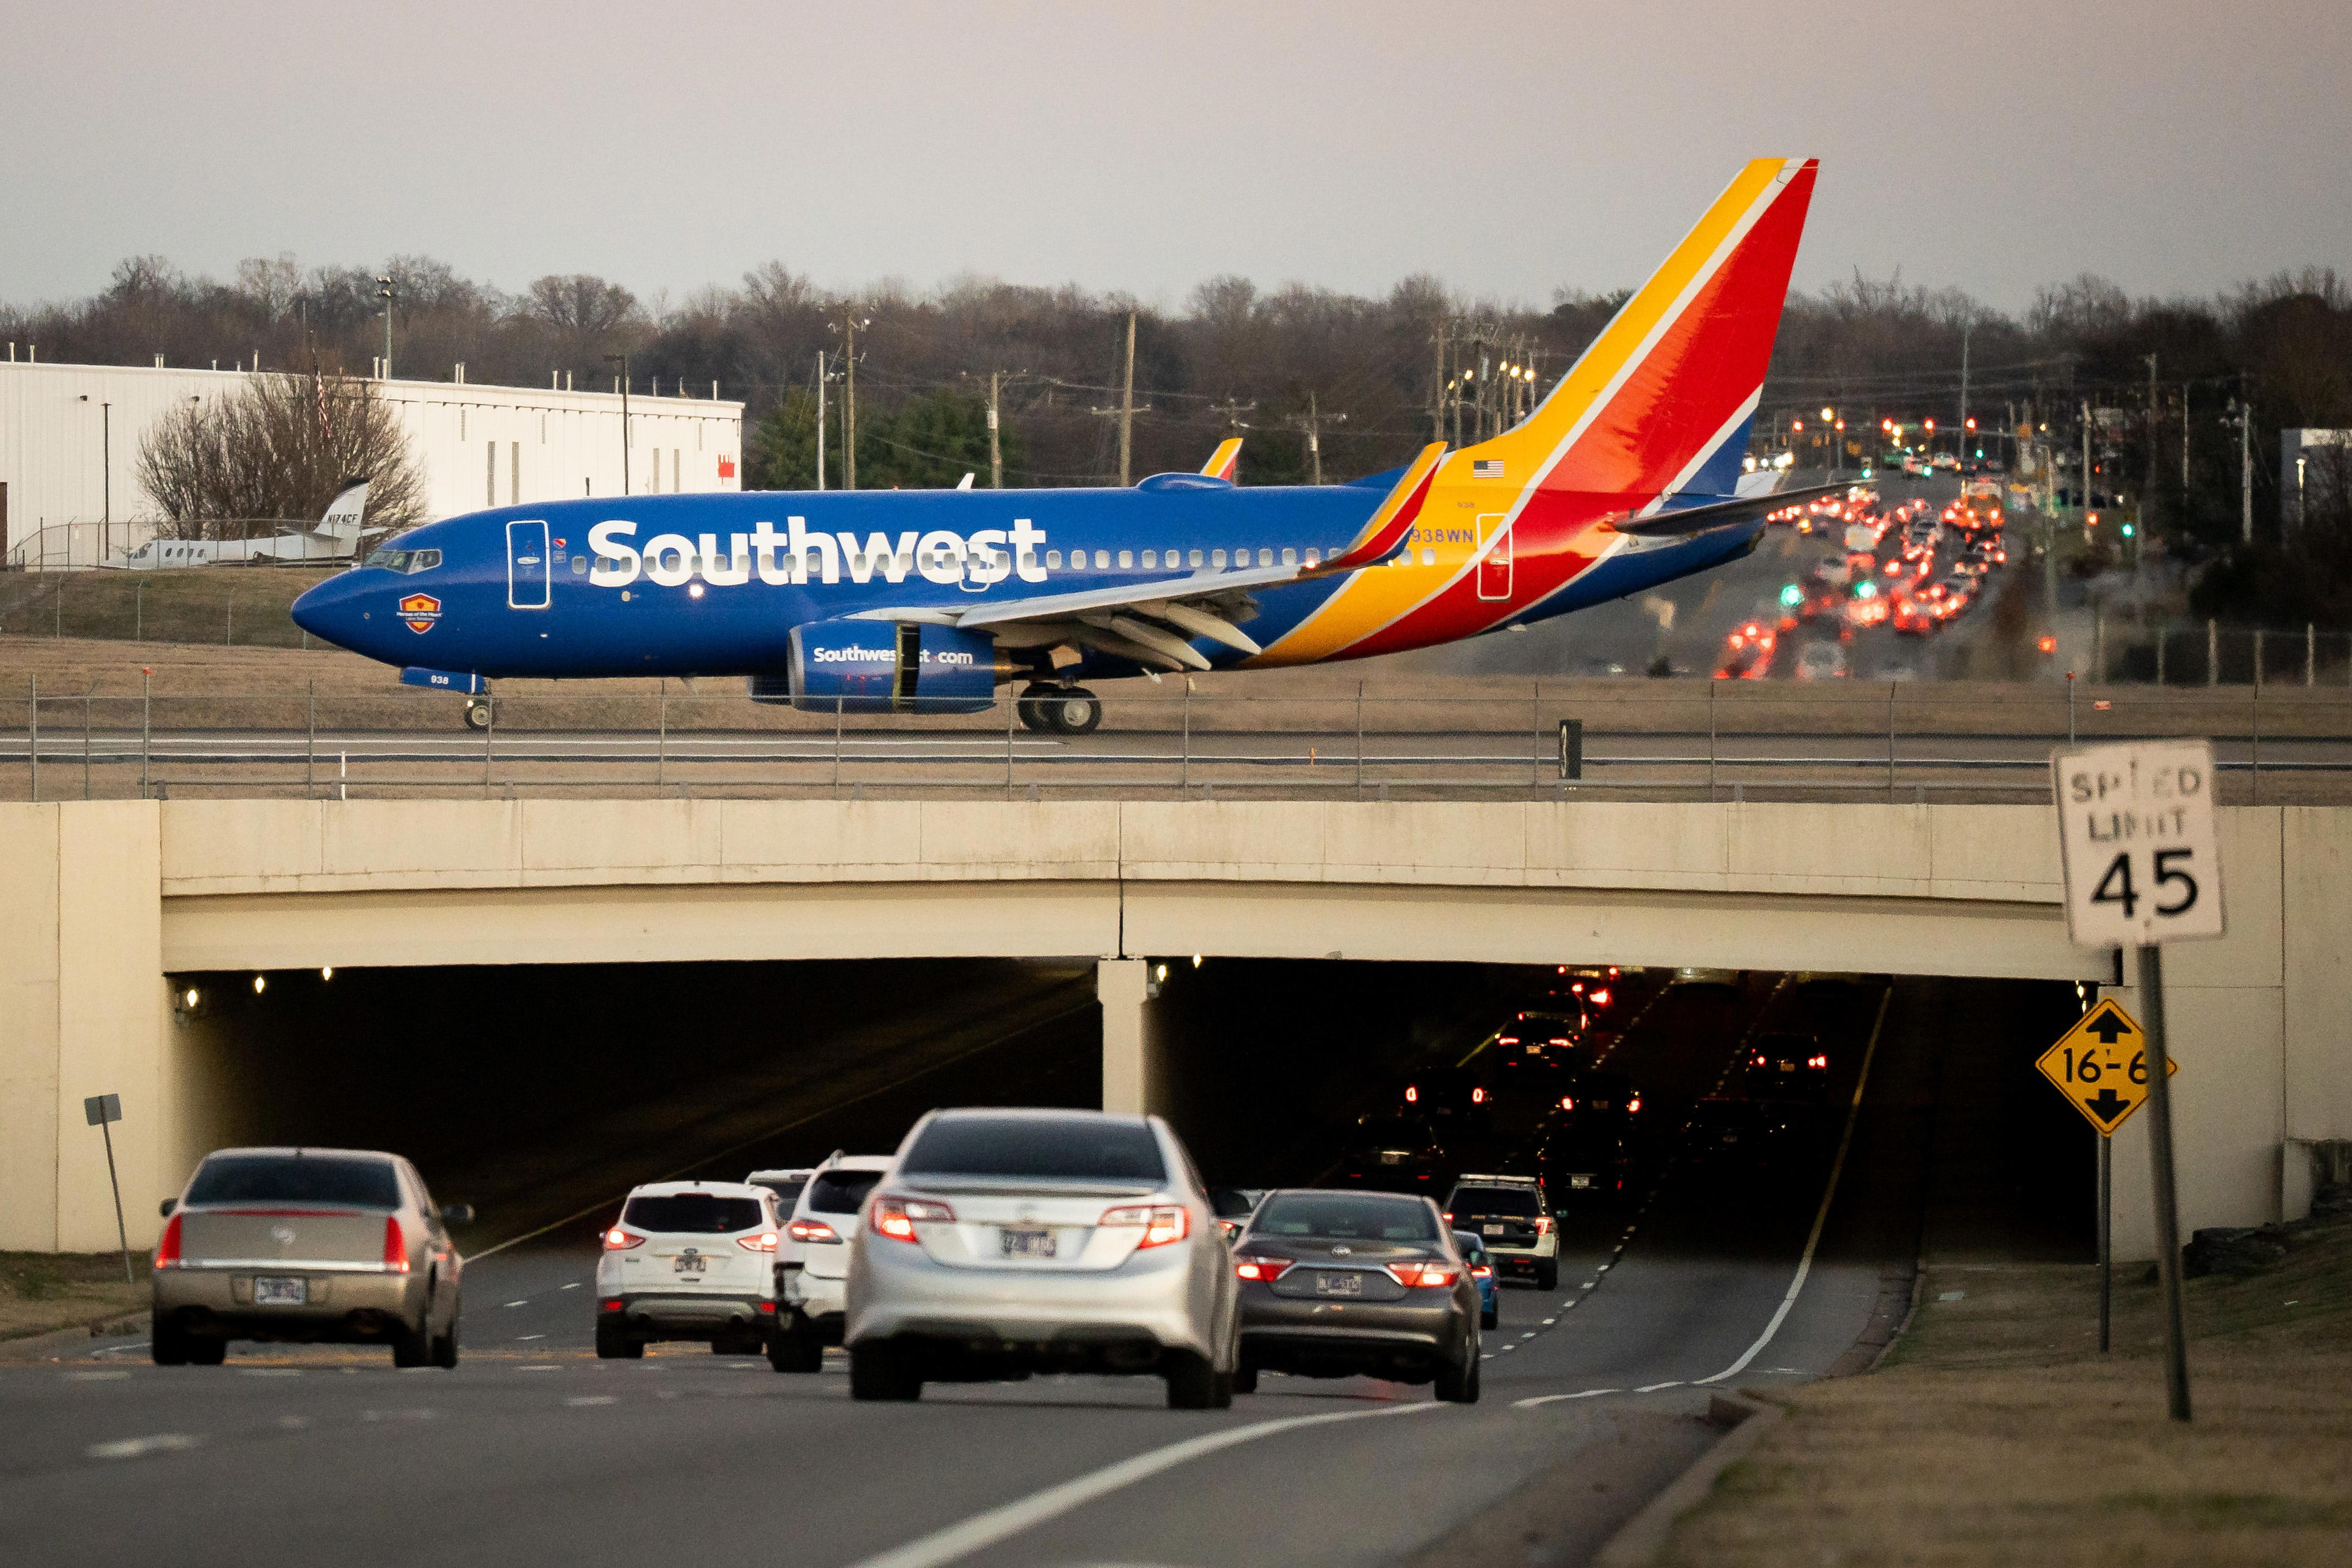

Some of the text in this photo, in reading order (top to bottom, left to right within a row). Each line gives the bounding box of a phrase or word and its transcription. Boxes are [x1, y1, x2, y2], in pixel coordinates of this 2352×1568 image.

[588, 516, 1048, 587] Southwest
[431, 675, 449, 685] 938
[2071, 764, 2202, 803] SPED
[2090, 846, 2198, 918] 45
